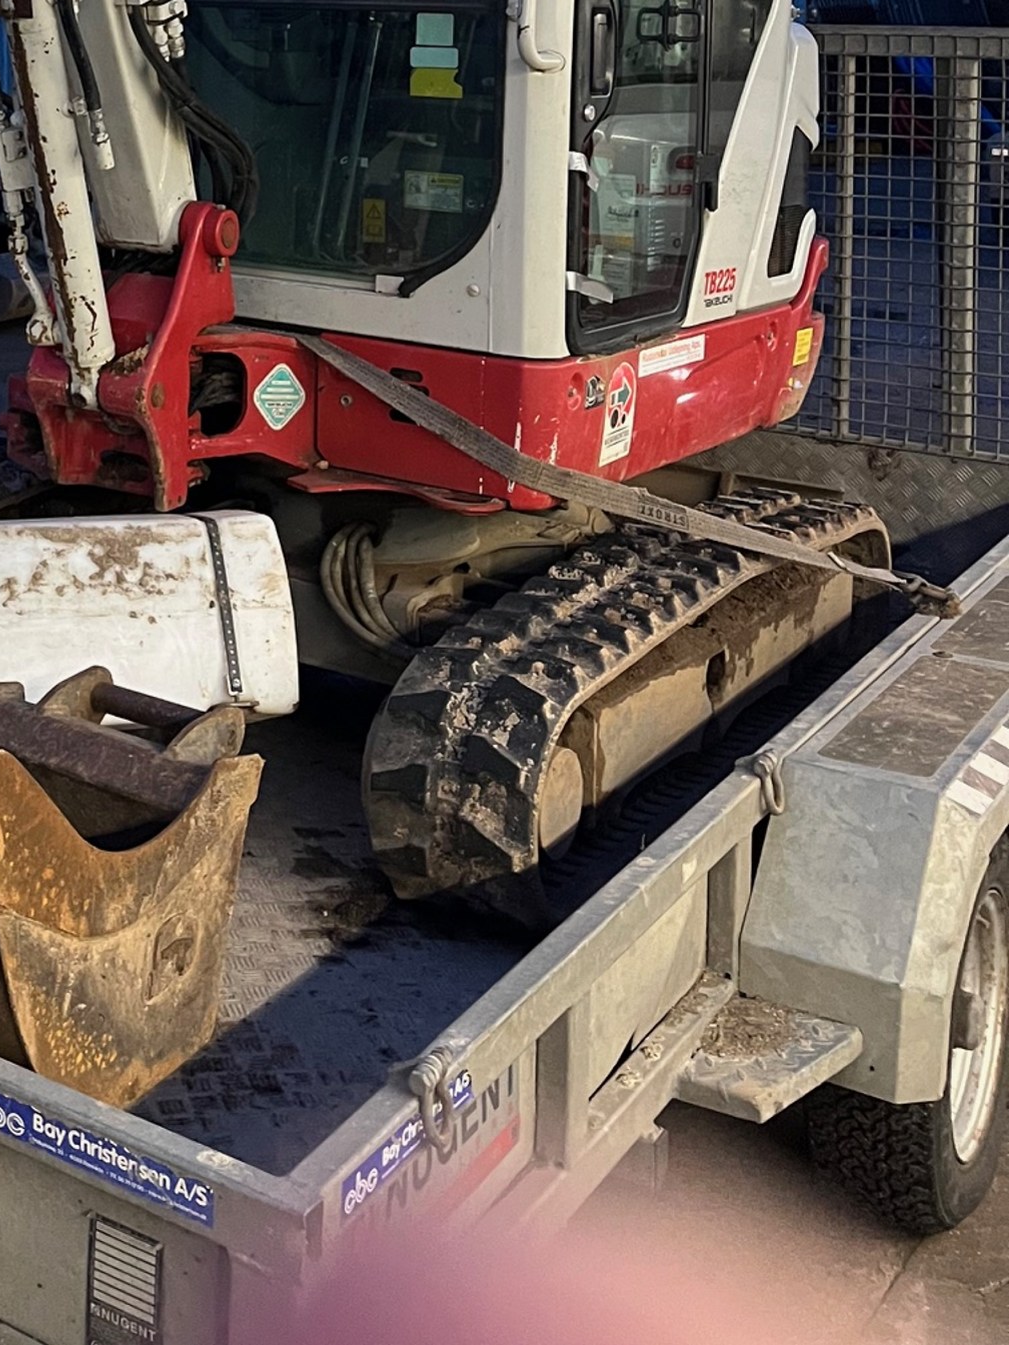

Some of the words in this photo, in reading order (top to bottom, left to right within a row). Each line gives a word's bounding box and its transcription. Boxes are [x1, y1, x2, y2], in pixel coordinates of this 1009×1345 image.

[704, 267, 736, 296] TB225
[33, 1113, 67, 1147] Bay
[68, 1129, 171, 1191] Christensen
[101, 1307, 156, 1342] NUGENT
